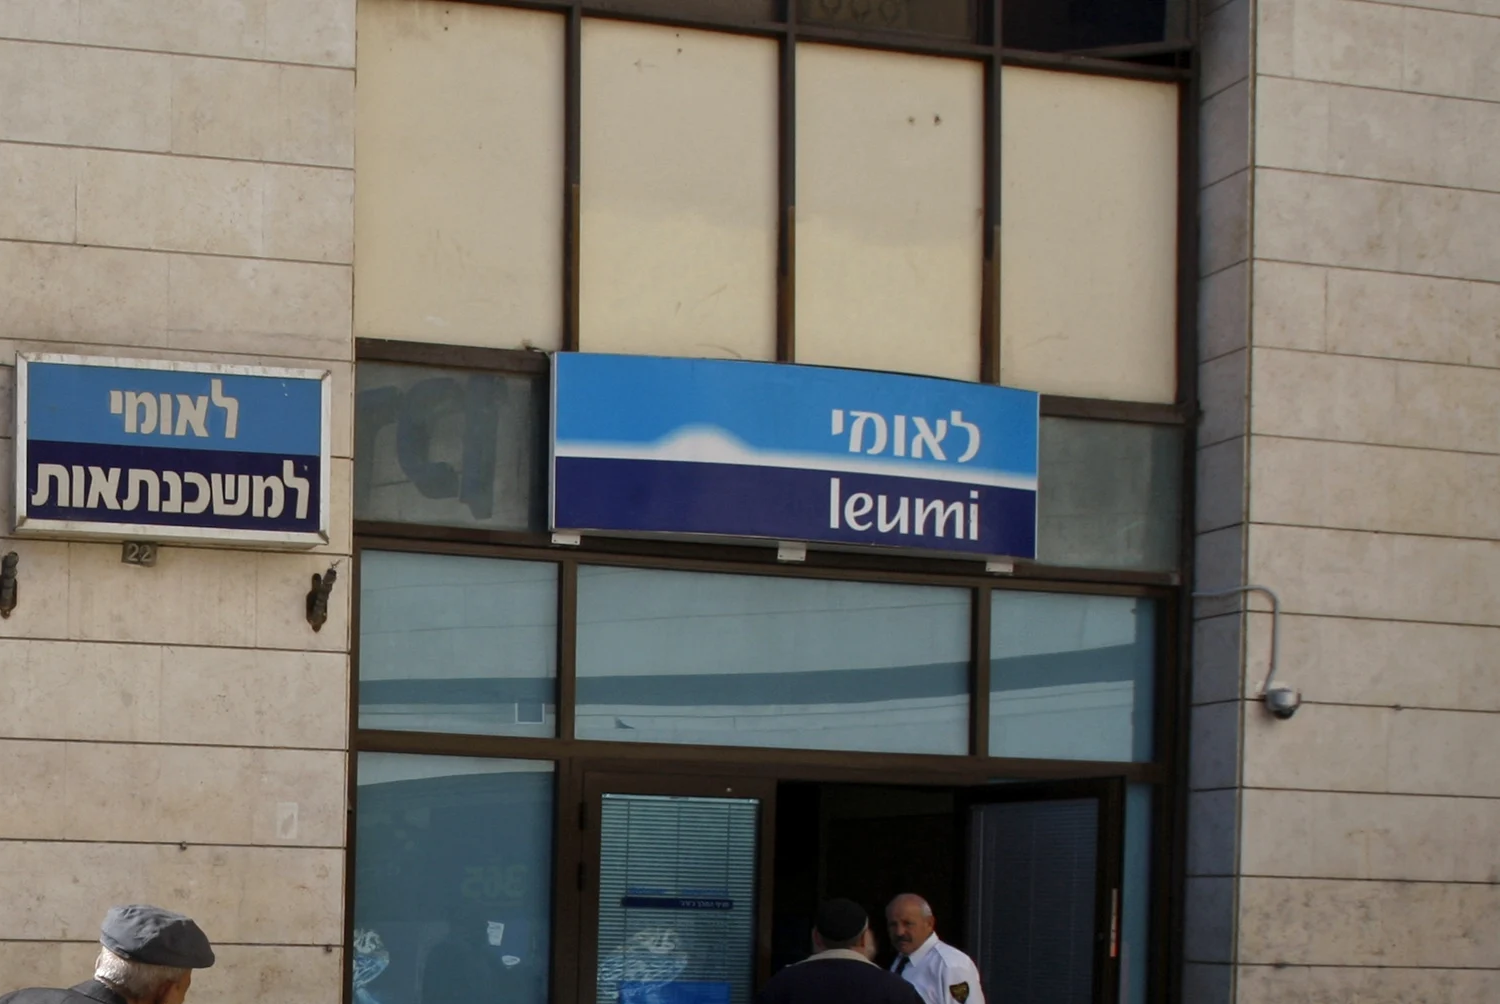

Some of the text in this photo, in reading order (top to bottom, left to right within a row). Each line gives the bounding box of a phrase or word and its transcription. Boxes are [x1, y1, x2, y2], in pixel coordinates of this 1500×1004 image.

[109, 378, 239, 439] לאומי
[831, 408, 982, 463] לאומי
[31, 460, 310, 520] למשכנתאות
[830, 477, 979, 541] leumi
